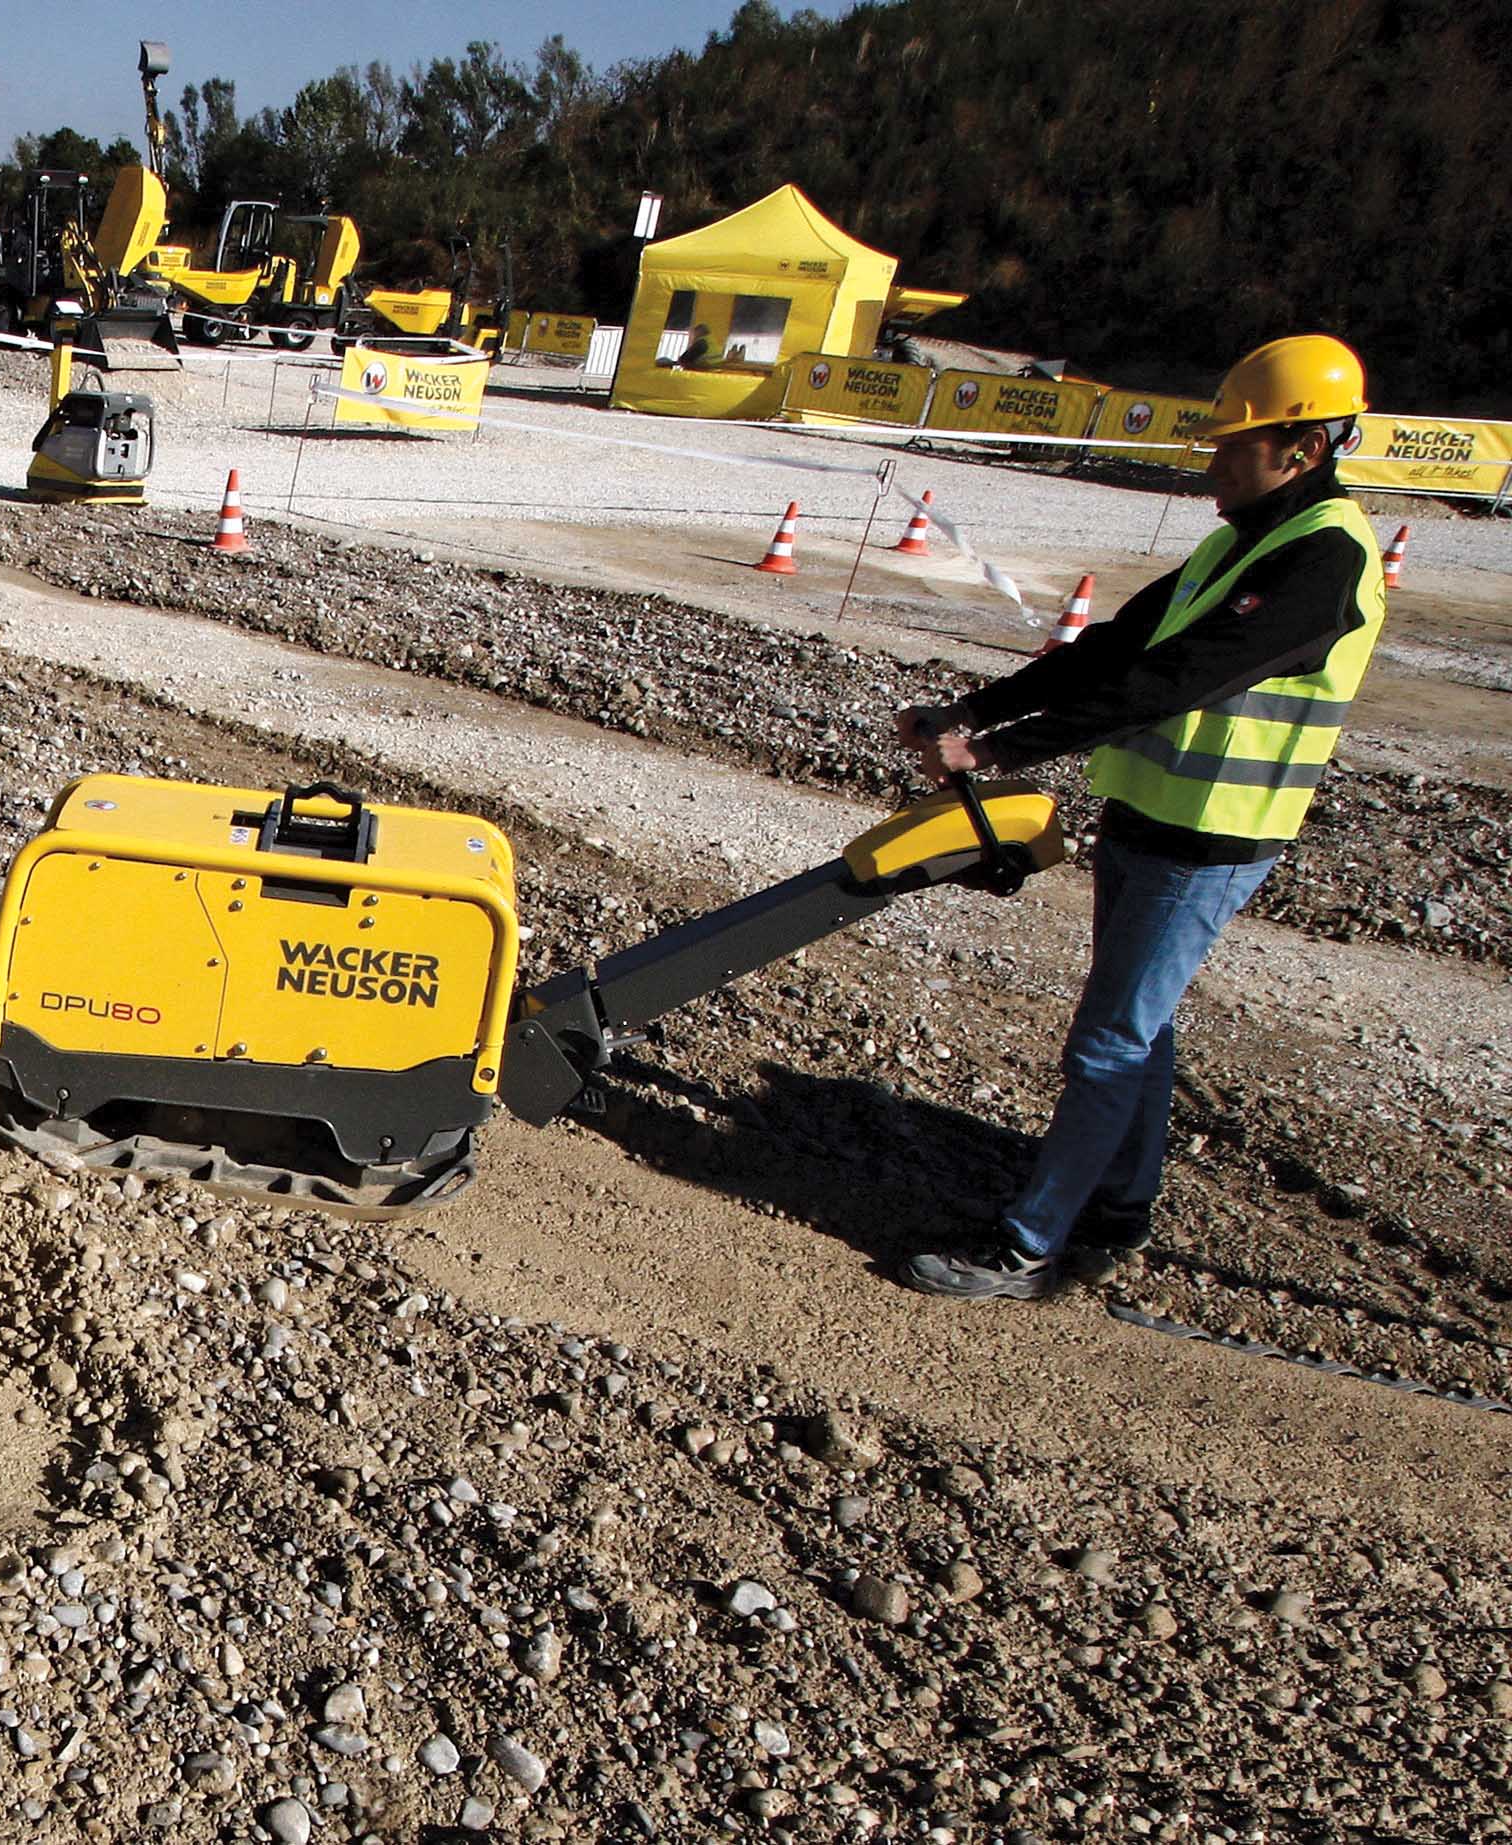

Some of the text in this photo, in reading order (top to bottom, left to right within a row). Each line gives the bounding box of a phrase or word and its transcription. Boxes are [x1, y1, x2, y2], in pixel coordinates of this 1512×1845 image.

[848, 367, 900, 385] WACKER
[403, 384, 462, 401] NEUSON
[844, 380, 899, 398] NEUSON
[999, 385, 1059, 406] WACKER
[994, 400, 1057, 419] NEUSON
[1392, 429, 1475, 448] WACKER
[1384, 445, 1473, 461] NEUSON
[279, 939, 439, 981] WACKER
[276, 966, 439, 1009] NEUSON
[40, 992, 162, 1025] DPU80
